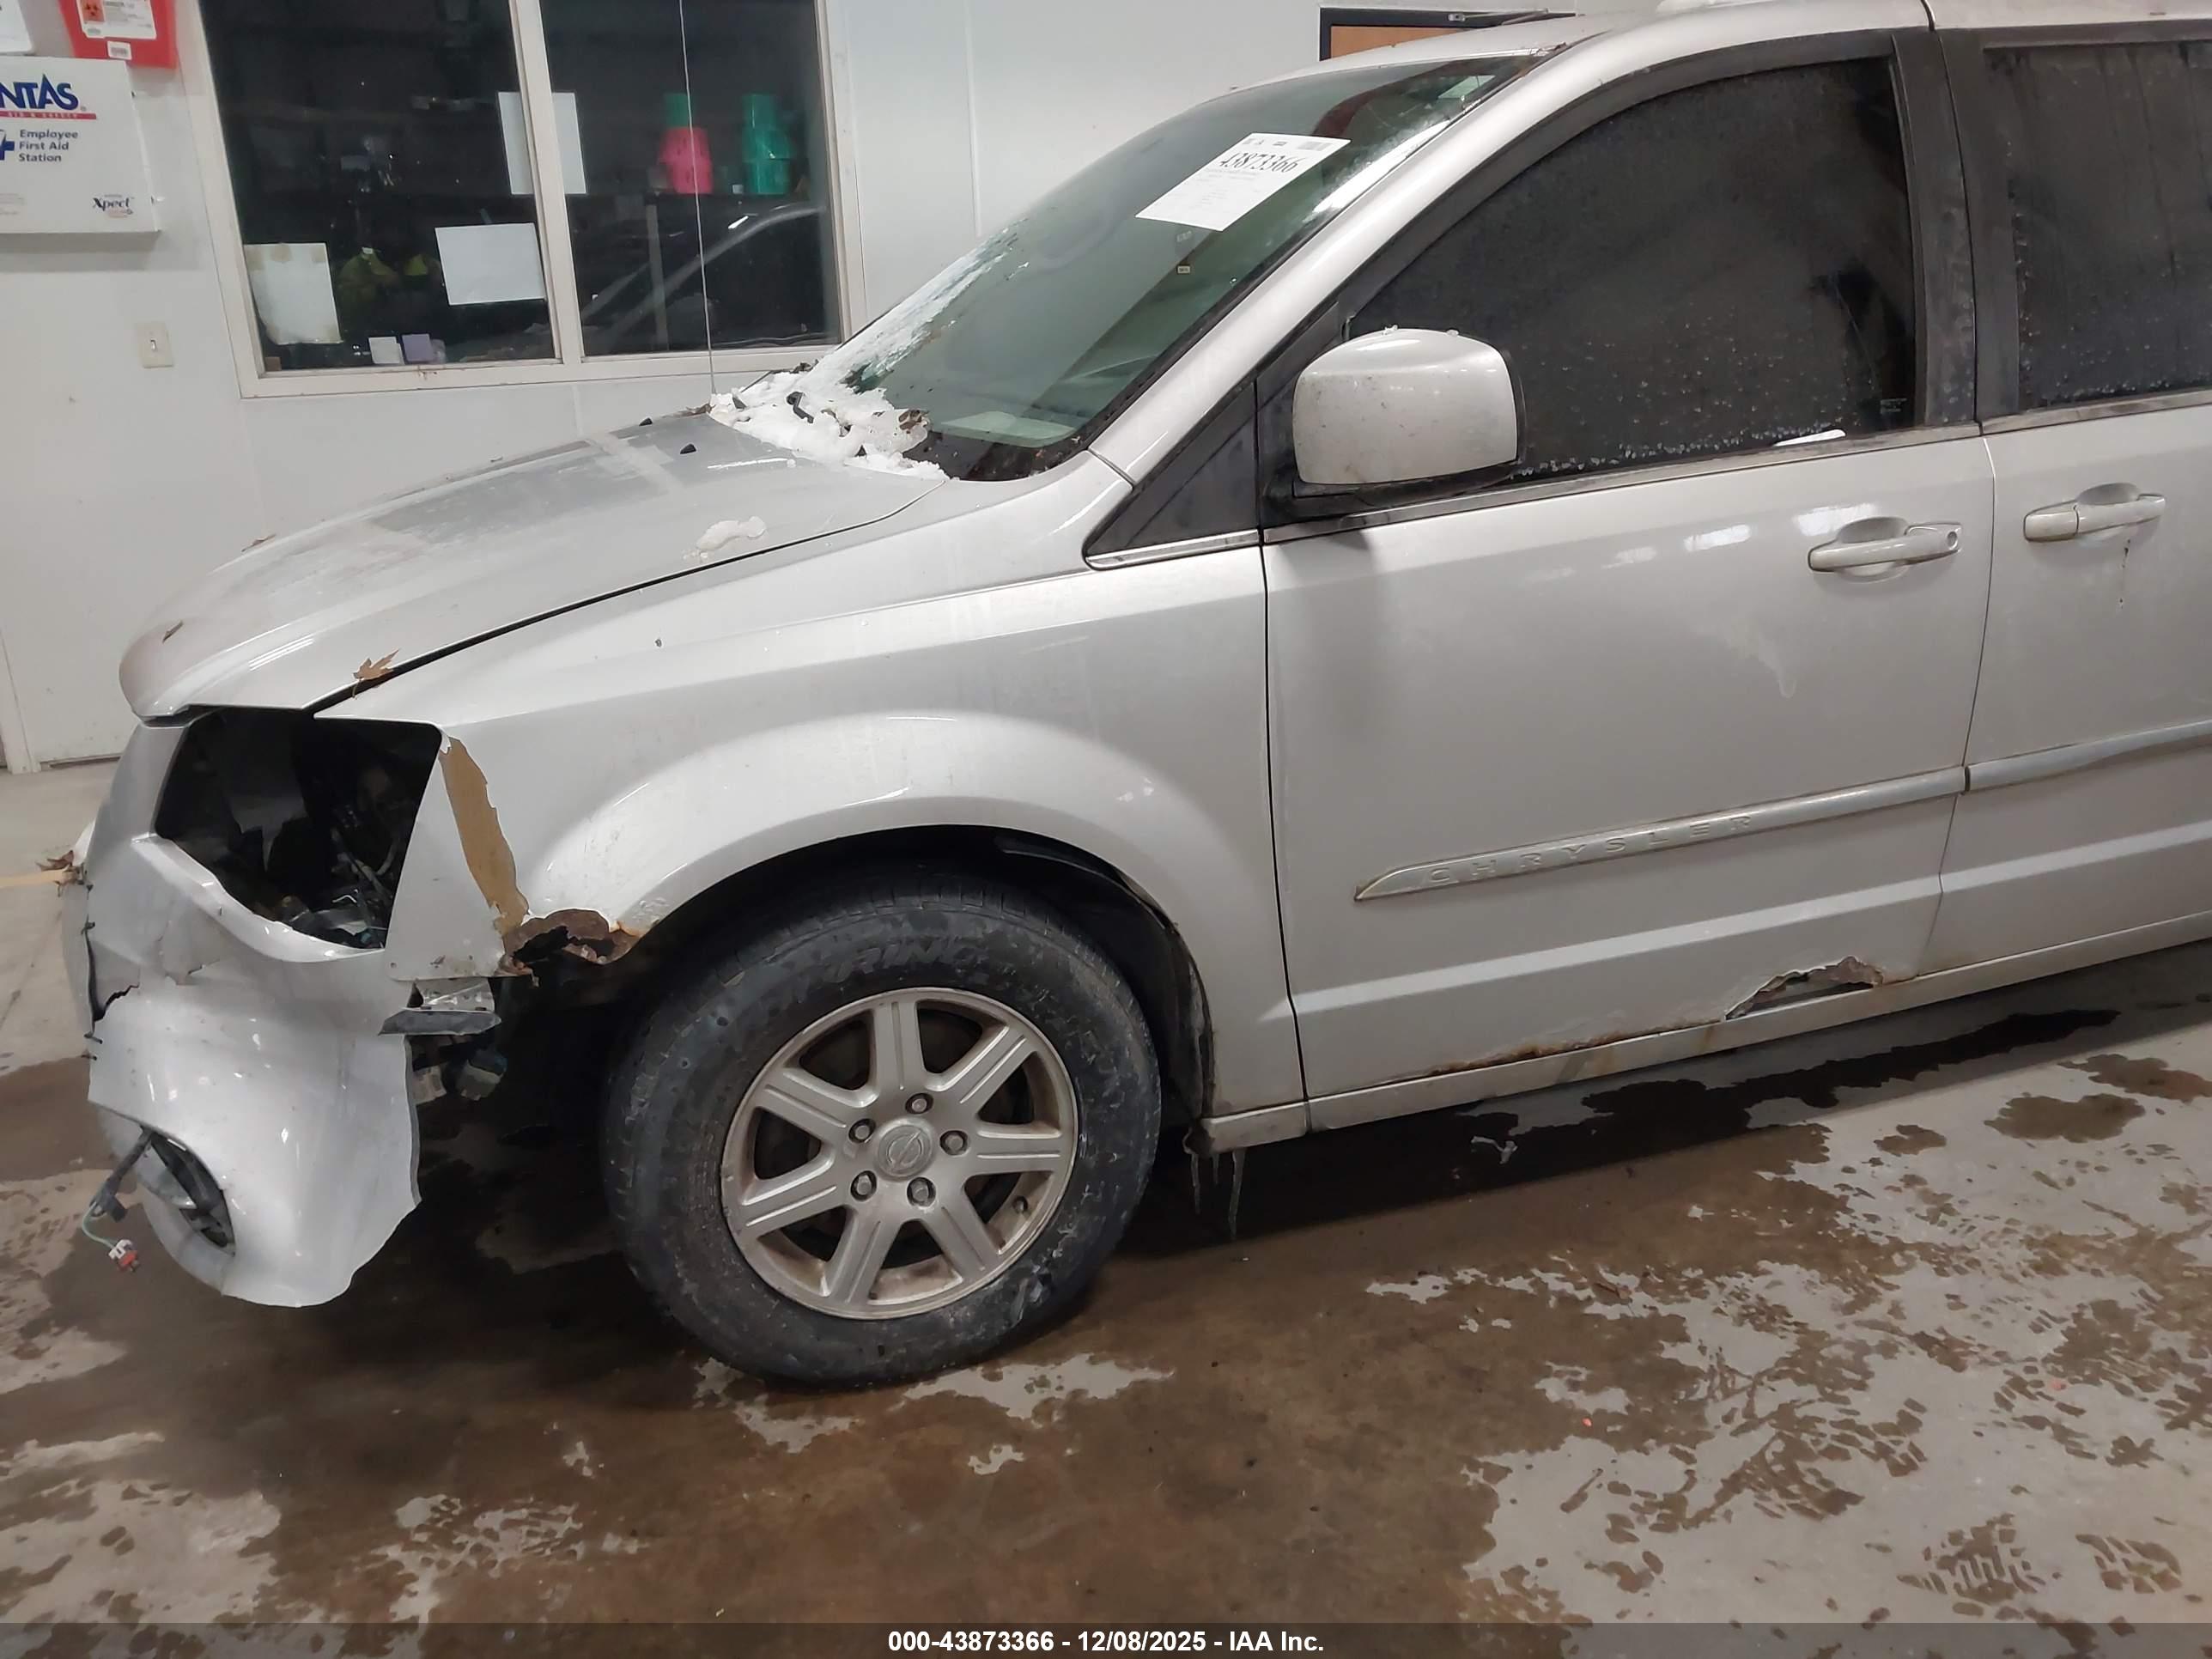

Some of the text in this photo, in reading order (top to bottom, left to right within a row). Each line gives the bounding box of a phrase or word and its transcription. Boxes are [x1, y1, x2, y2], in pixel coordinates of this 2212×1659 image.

[19, 129, 78, 140] Employee
[19, 141, 70, 150] First Aid
[18, 152, 62, 162] Station
[92, 197, 130, 212] Xpect
[1427, 815, 1753, 883] CHRYSLER
